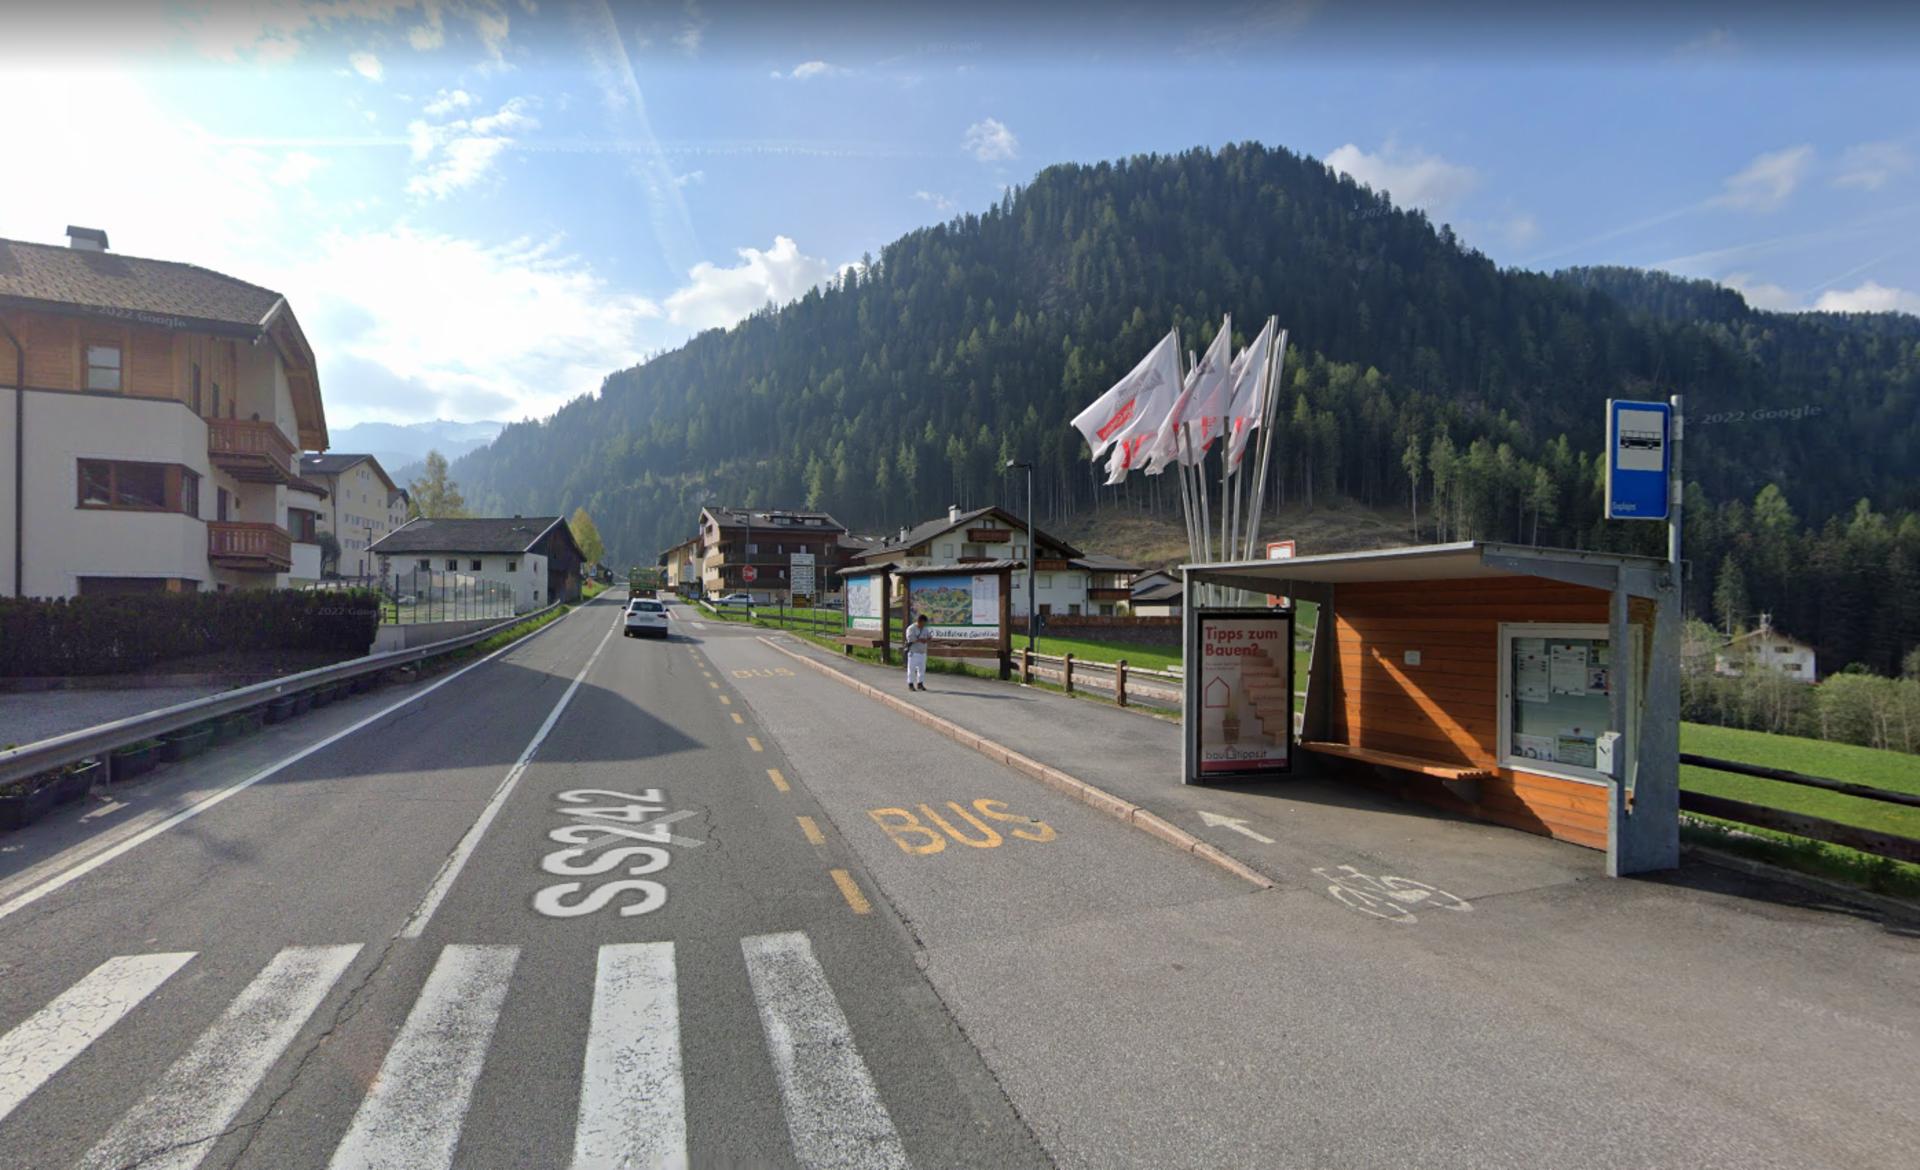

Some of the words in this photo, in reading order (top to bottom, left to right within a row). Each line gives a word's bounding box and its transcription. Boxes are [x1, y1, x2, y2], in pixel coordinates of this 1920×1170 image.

[1205, 626, 1244, 643] Tipps
[1247, 629, 1279, 640] zum
[1205, 643, 1260, 657] Bauen?
[731, 666, 796, 679] BUS
[866, 798, 1057, 856] BUS
[533, 787, 672, 918] SS242
